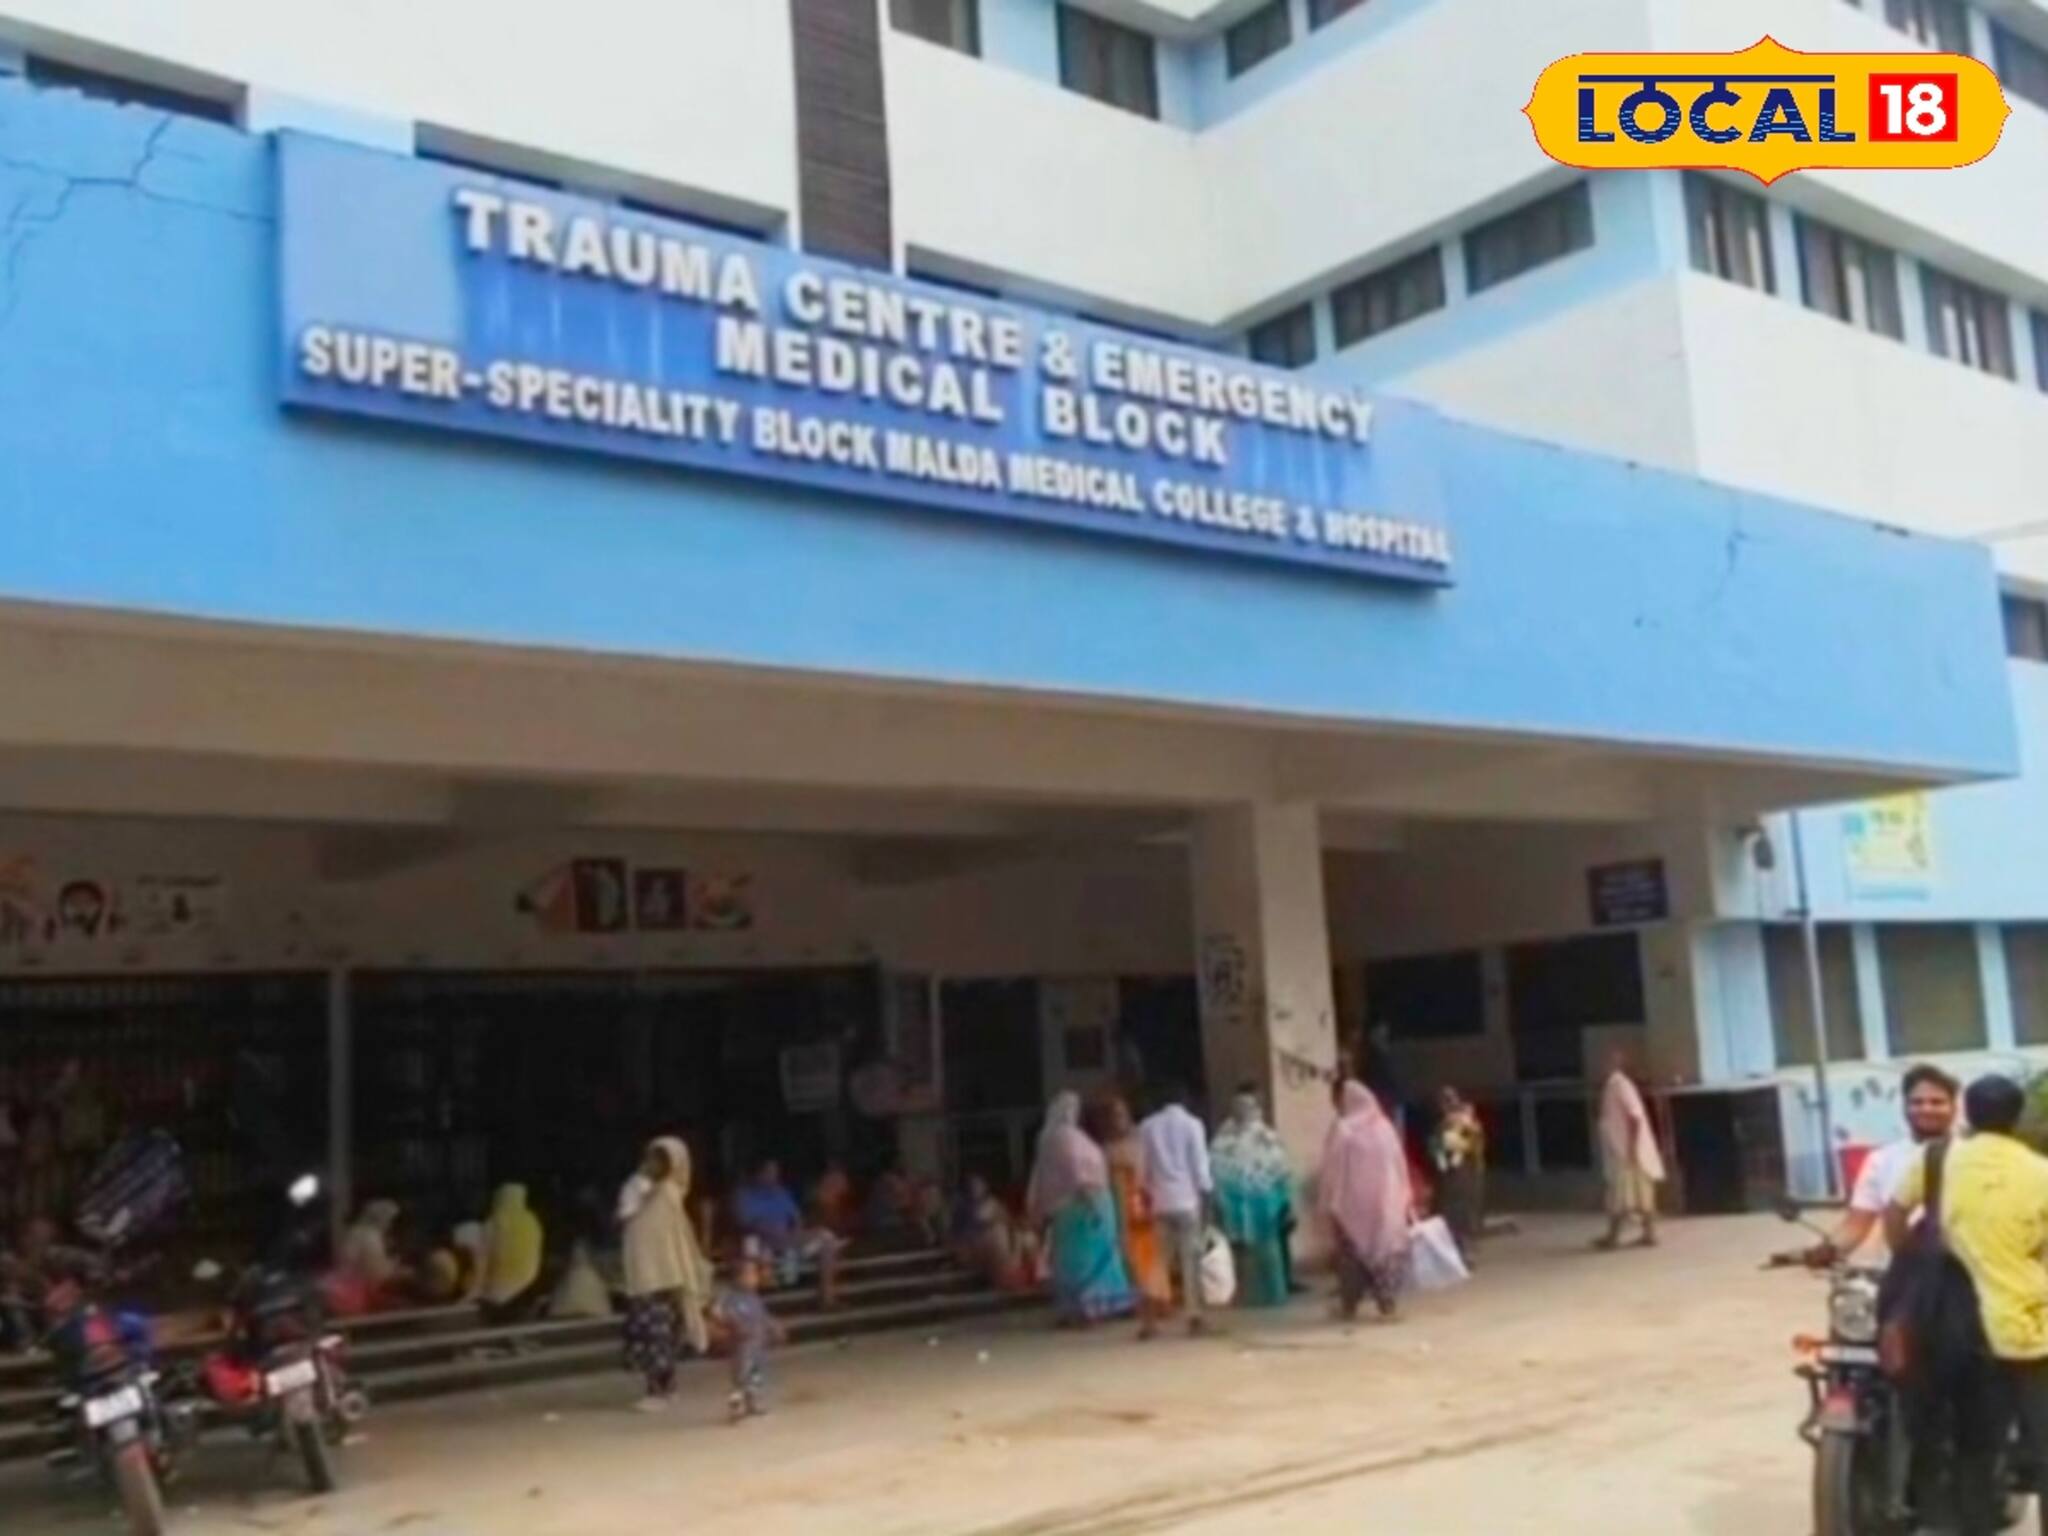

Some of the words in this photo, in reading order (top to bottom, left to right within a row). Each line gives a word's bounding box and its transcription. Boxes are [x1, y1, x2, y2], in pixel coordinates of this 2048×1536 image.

[454, 188, 760, 312] TRAUMA
[784, 270, 1024, 369] CENTRE
[1042, 329, 1077, 379] &
[1092, 341, 1374, 443] EMERGENCY
[716, 315, 1004, 422] MEDICAL
[1042, 386, 1228, 465] BLOCK
[301, 326, 740, 443] SUPER-SPECIALITY
[753, 406, 880, 468] BLOCK
[882, 429, 1002, 488] MALDA
[1007, 452, 1146, 513] MEDICAL
[1153, 477, 1288, 537] COLLEGE
[1296, 506, 1319, 541] &
[1322, 510, 1453, 565] HOSPITAL
